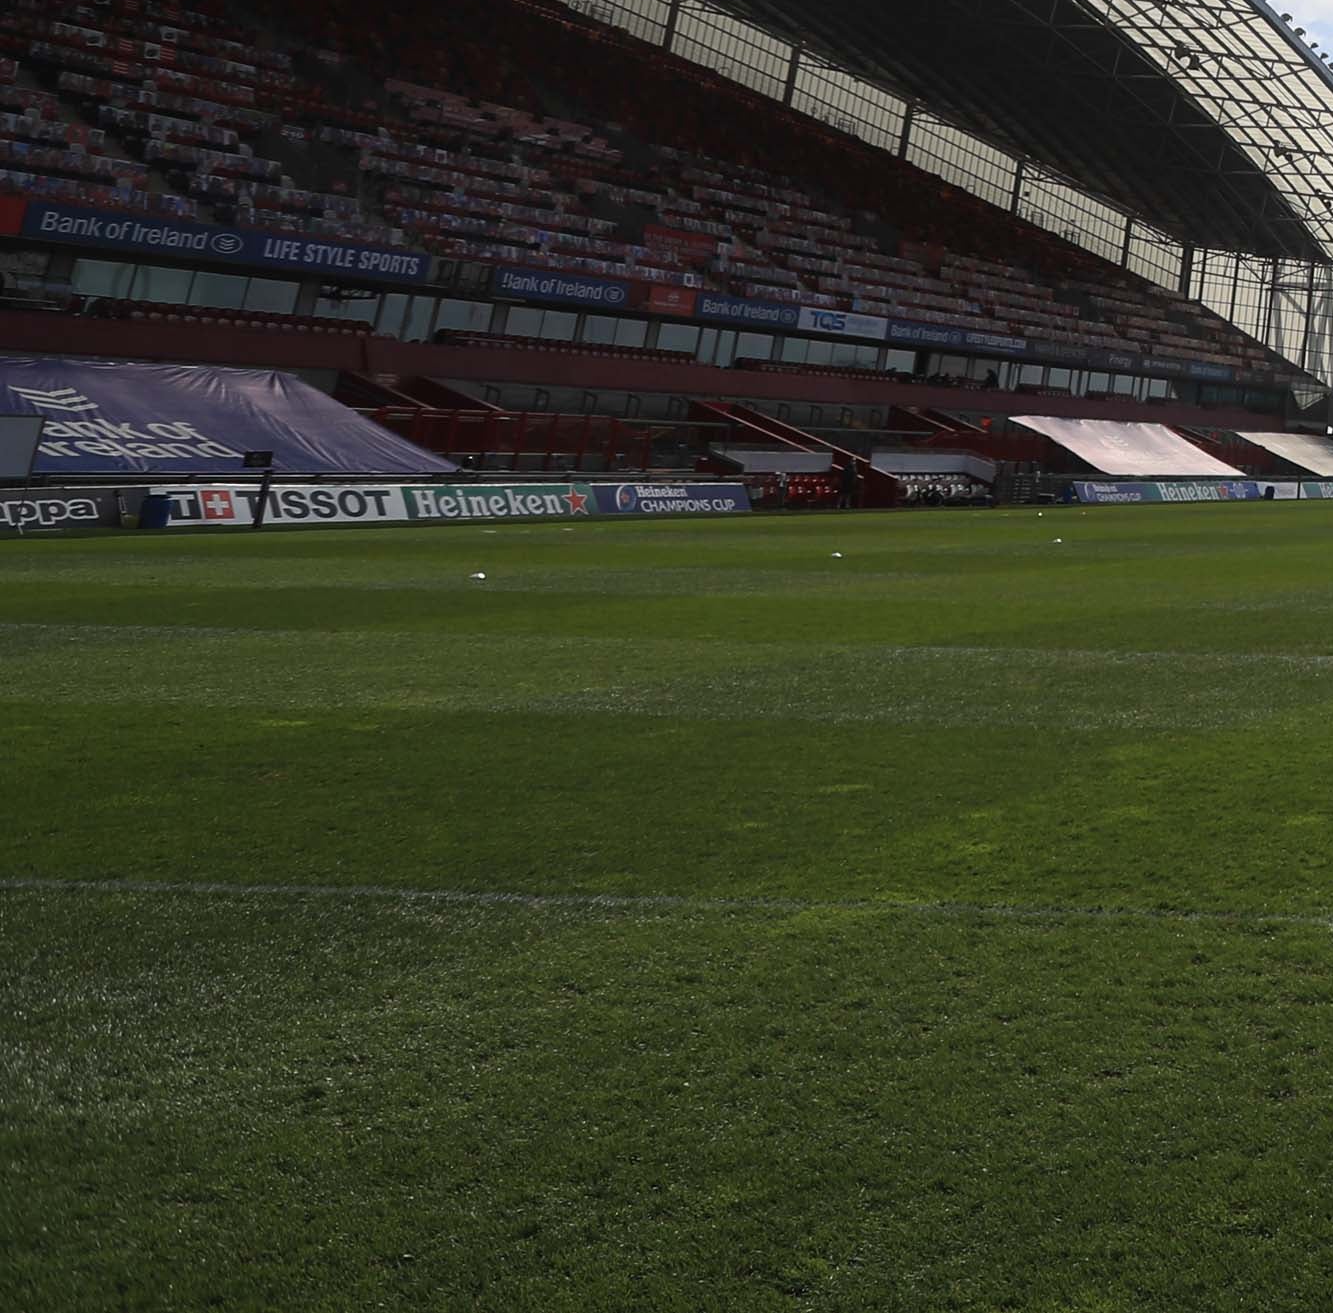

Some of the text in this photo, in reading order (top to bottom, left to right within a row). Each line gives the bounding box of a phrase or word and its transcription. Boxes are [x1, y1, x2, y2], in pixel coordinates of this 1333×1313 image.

[40, 210, 208, 250] Bank of Ireland
[264, 238, 420, 276] LIFE STYLE SPORTS
[540, 278, 558, 293] of
[556, 279, 602, 300] Ireland
[702, 299, 729, 315] Bank
[742, 304, 780, 321] Ireland
[44, 418, 209, 440] ank of
[635, 486, 688, 499] Heineken
[1156, 482, 1219, 502] Heineken
[0, 499, 99, 526] ppa
[236, 490, 391, 519] TISSOT
[411, 489, 563, 518] Heineken
[640, 498, 736, 513] CHAMPIONS CUP
